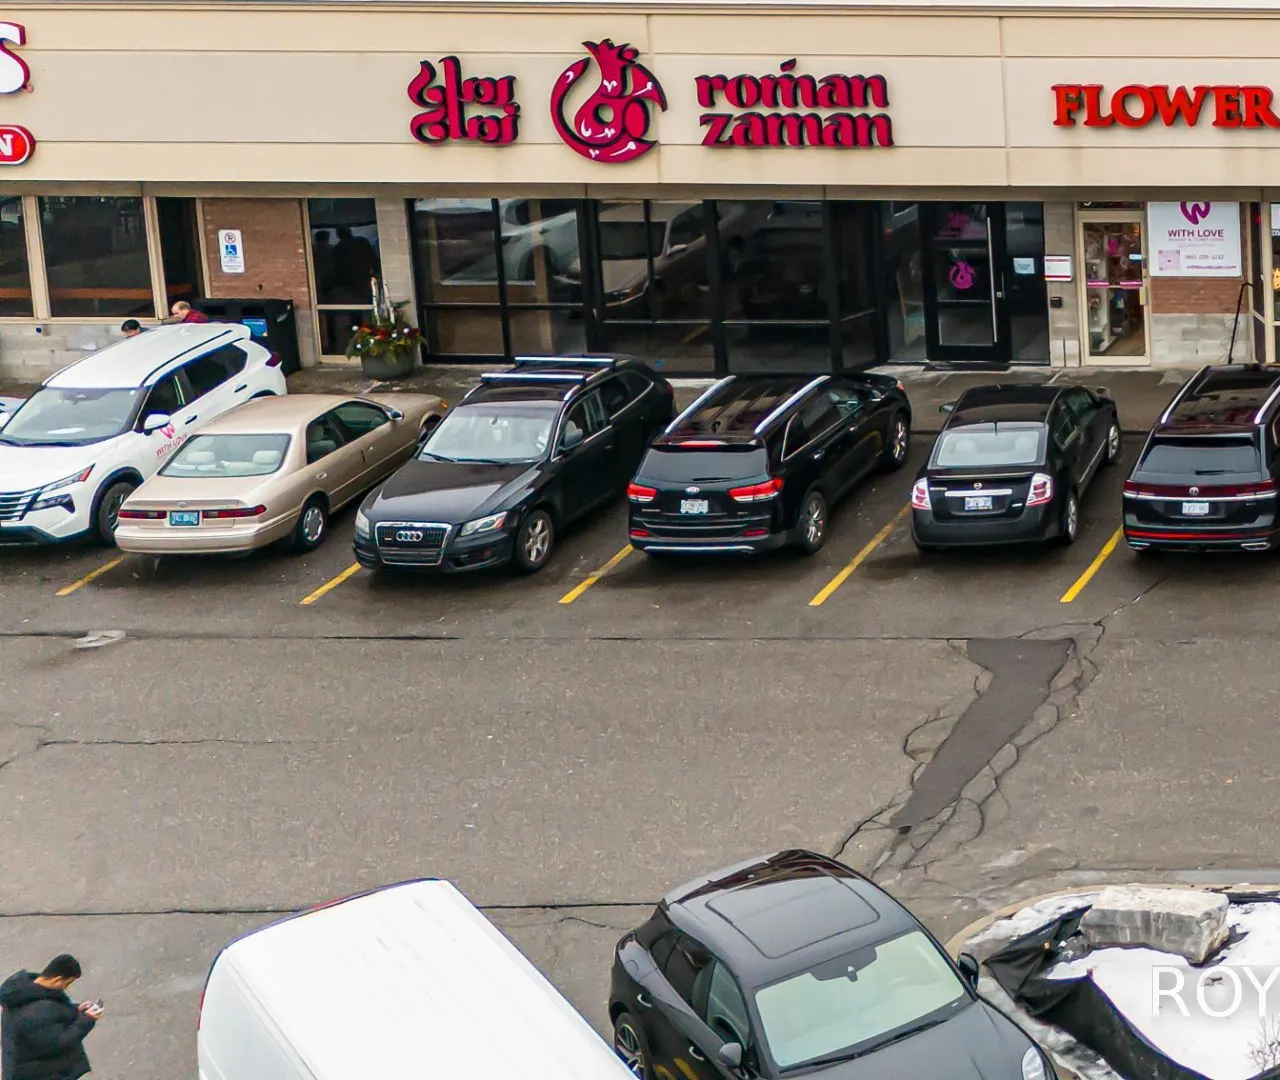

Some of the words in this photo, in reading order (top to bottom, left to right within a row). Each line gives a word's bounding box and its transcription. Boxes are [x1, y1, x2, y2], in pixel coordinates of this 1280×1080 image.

[700, 112, 895, 148] zaman
[1167, 229, 1194, 238] WITH
[1197, 229, 1225, 238] LOVE
